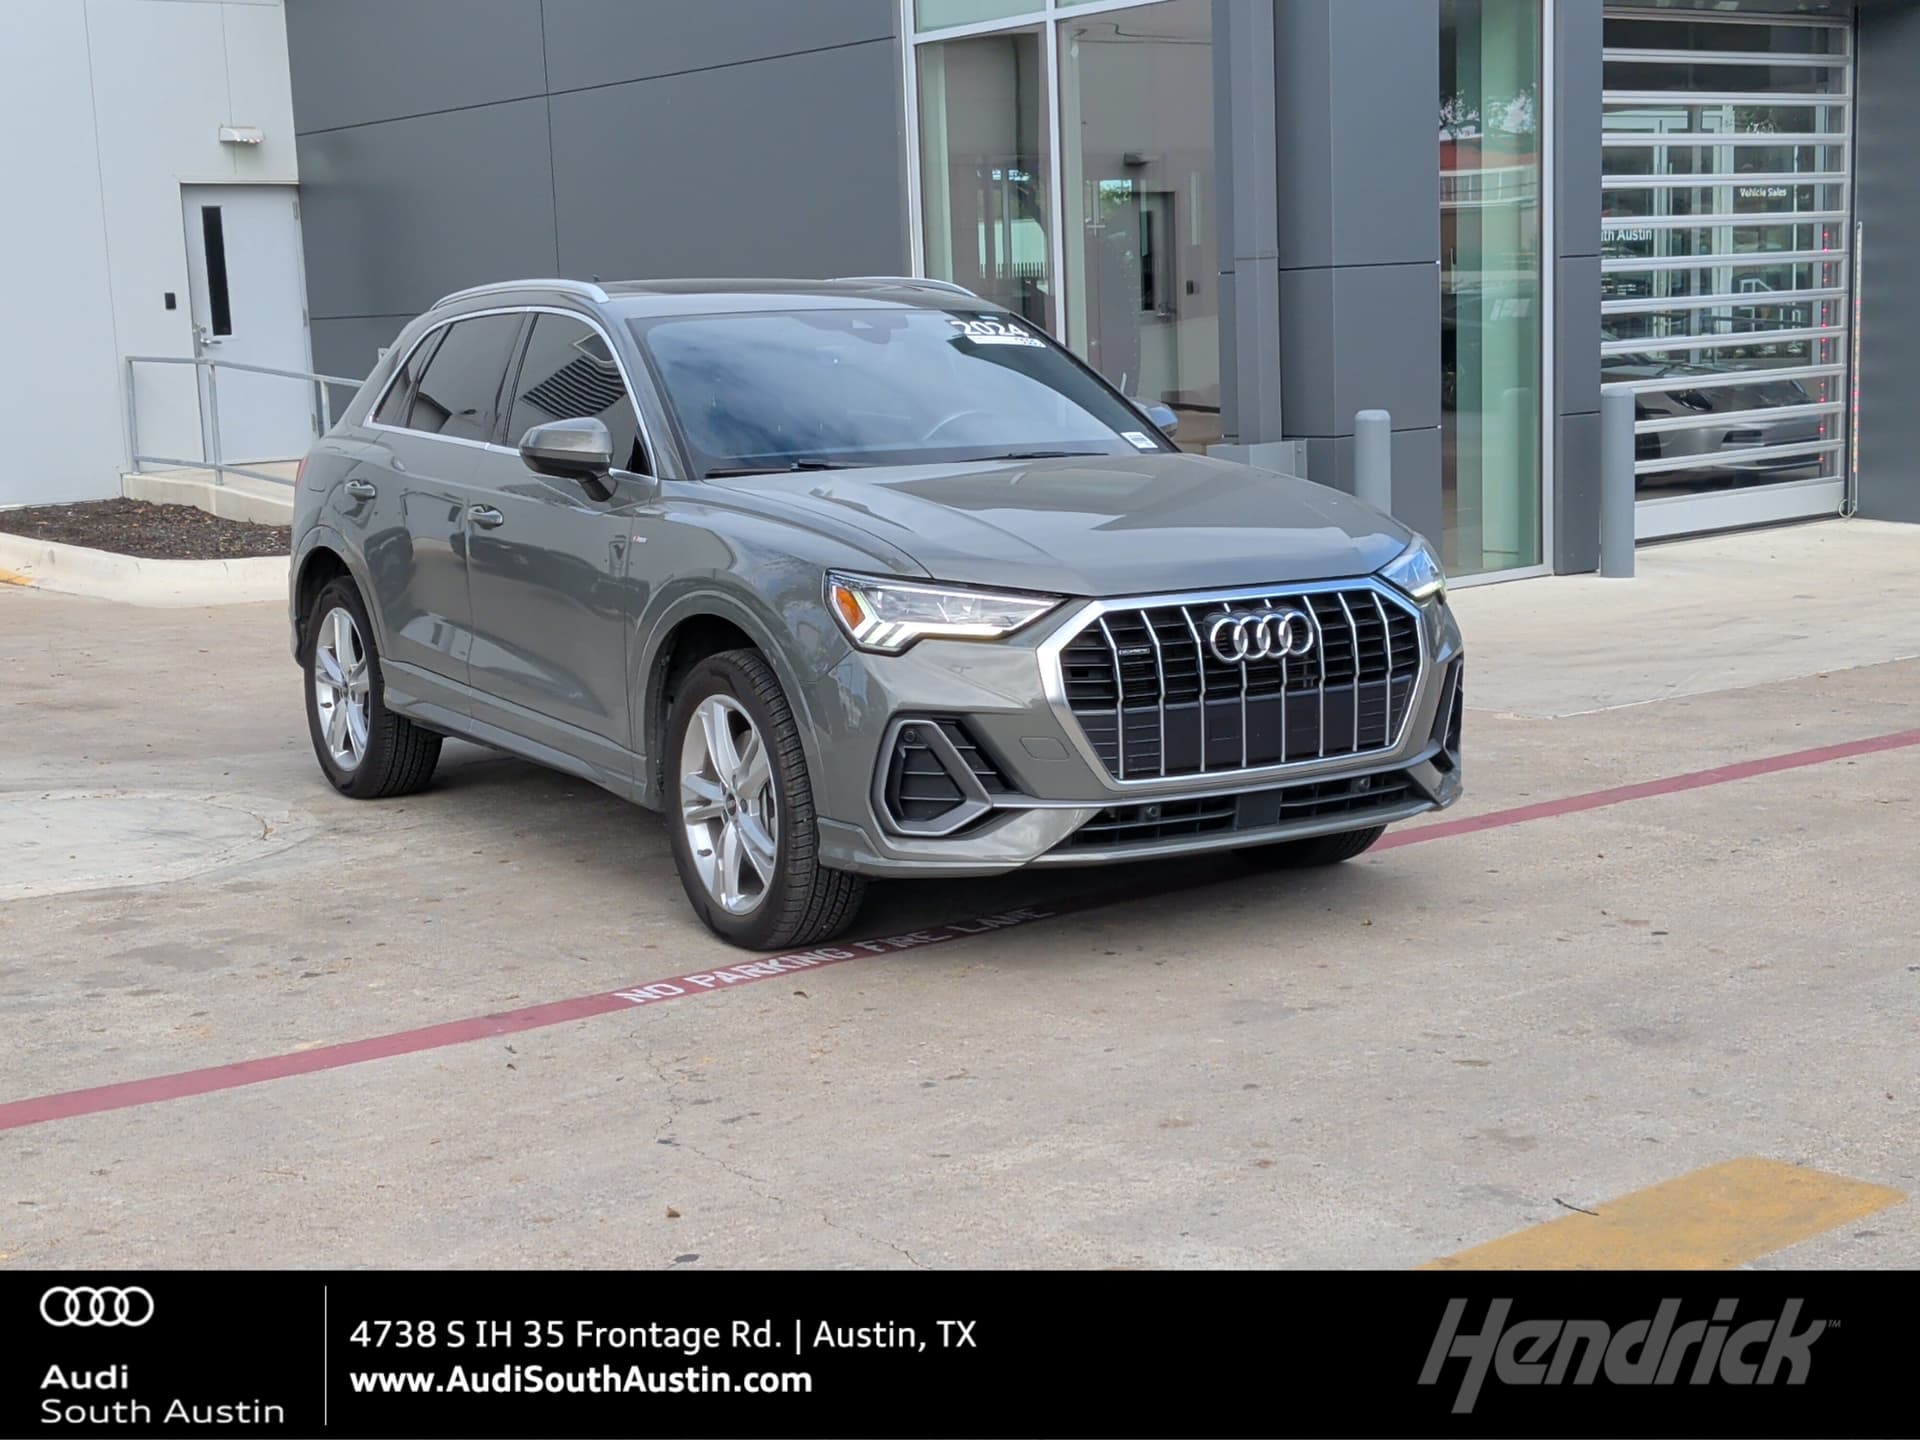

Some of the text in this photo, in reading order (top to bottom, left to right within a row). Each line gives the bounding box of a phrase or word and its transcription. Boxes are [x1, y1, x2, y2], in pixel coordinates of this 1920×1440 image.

[1740, 187, 1787, 197] Vehicle Sales
[1617, 228, 1652, 241] Austin
[950, 321, 1029, 338] 2024
[614, 908, 1056, 1003] NO PARKING FIRE LANE
